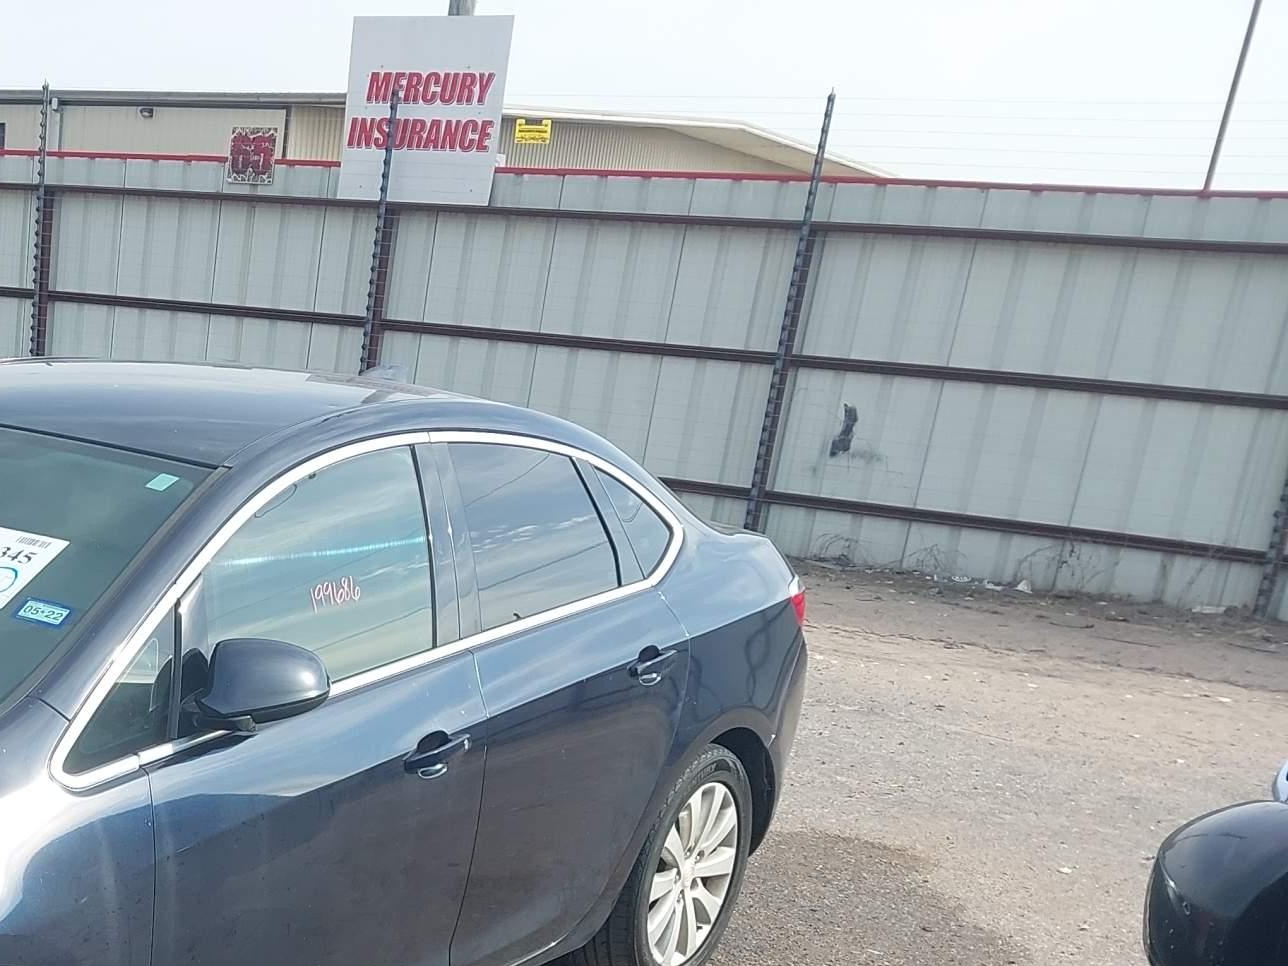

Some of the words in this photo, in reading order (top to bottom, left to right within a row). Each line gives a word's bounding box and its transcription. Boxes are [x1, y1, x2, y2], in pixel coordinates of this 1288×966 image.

[365, 71, 496, 106] MERCURY
[347, 116, 495, 152] INSURANCE
[310, 575, 361, 614] 199686
